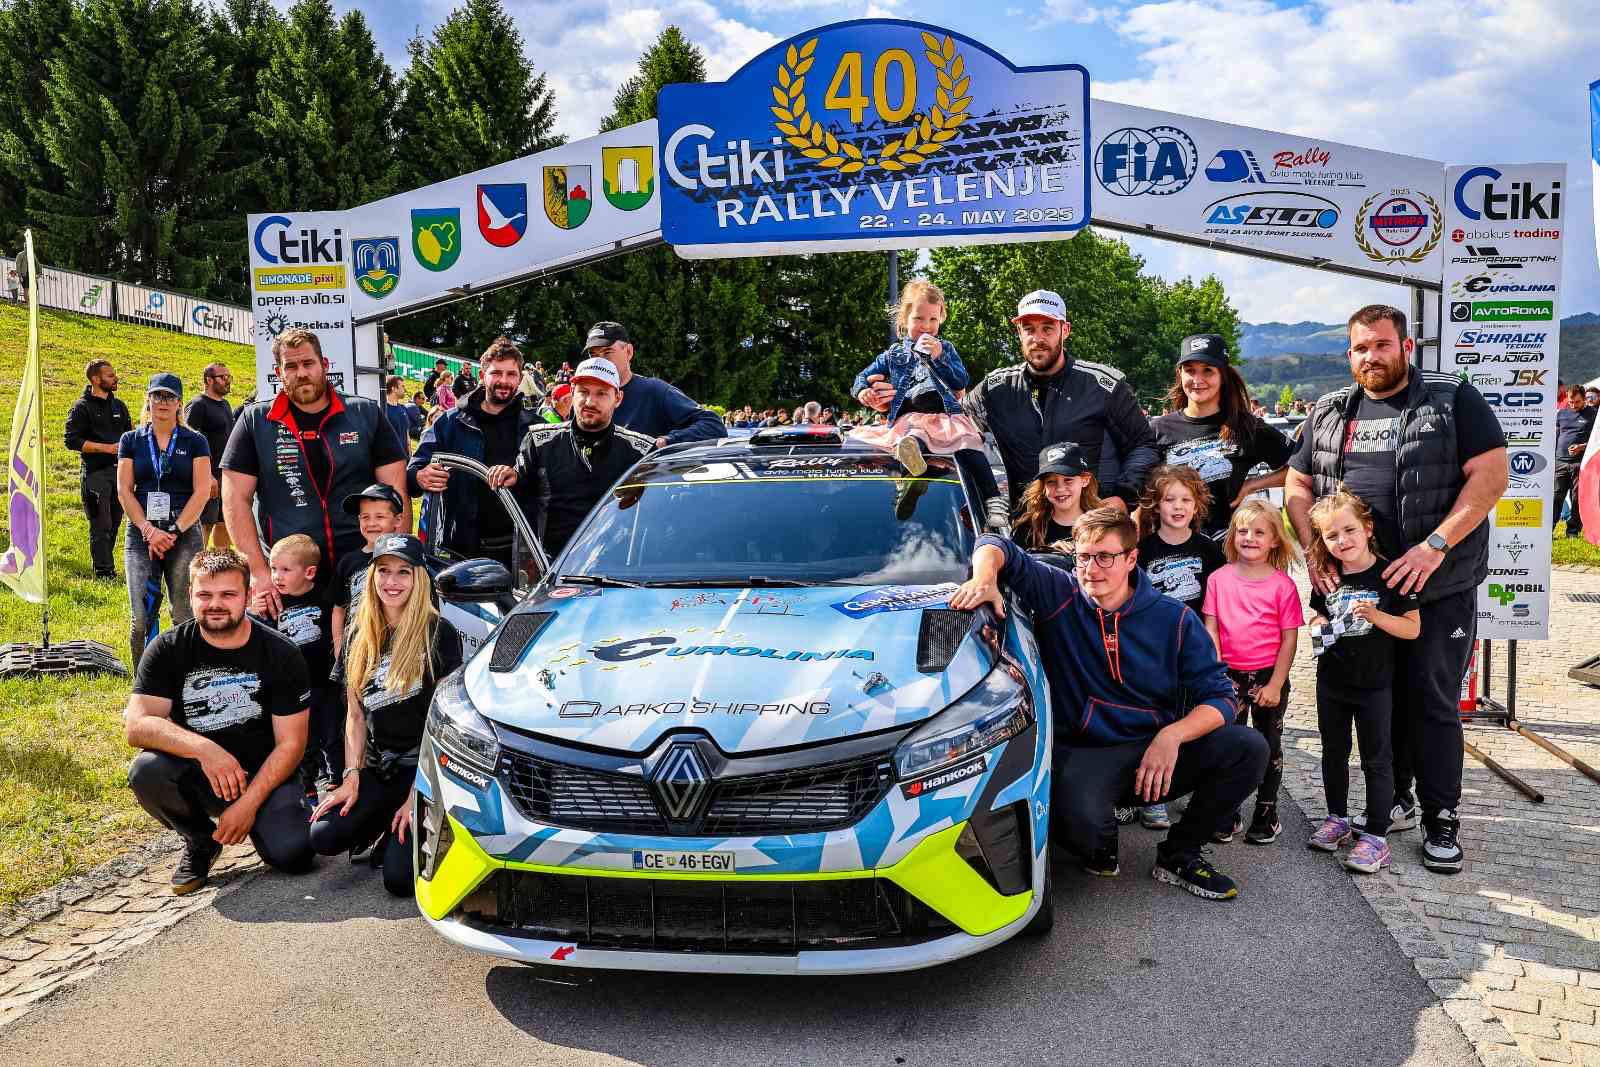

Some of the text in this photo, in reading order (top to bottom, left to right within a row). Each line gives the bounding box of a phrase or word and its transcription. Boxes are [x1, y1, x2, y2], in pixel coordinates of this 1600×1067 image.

[823, 48, 917, 125] 40
[1272, 147, 1332, 171] Rally
[716, 164, 1065, 229] RALLY VELENJE
[859, 216, 895, 229] 22.
[917, 214, 952, 226] 24.
[961, 211, 1006, 225] MAY
[1013, 208, 1074, 224] 2025
[1204, 227, 1228, 235] ZVEZA
[1466, 228, 1560, 240] abakus trading
[259, 272, 335, 286] LIMONADE pixi
[1474, 306, 1550, 317] AVTOROMA
[1461, 331, 1548, 344] SCHRACK
[1503, 369, 1549, 386] JSK
[768, 456, 843, 470] Rally
[1504, 583, 1545, 592] MOBIL
[558, 701, 832, 719] DARKO SHIPPING
[643, 853, 730, 870] CE 46-EGV
